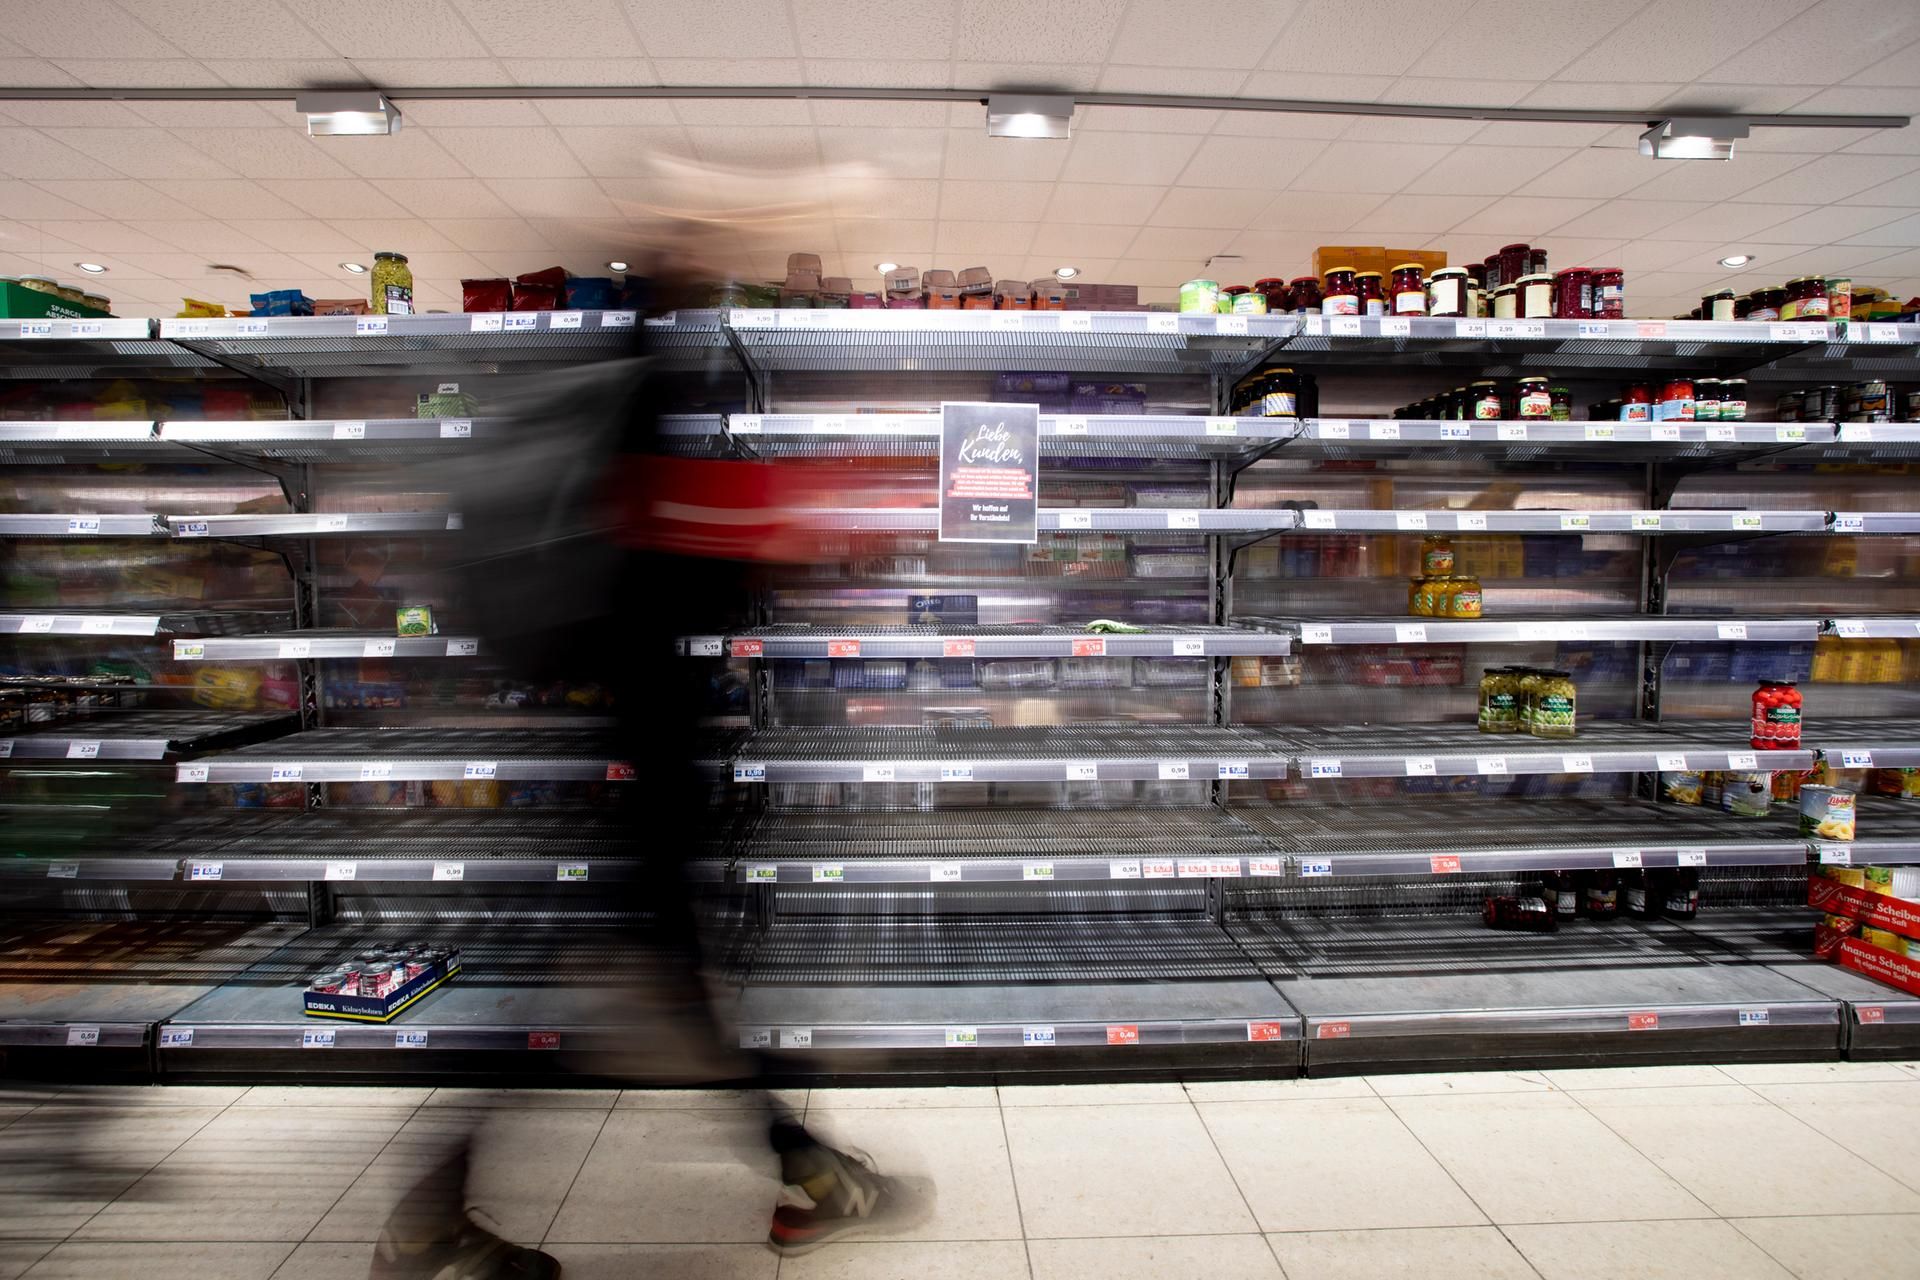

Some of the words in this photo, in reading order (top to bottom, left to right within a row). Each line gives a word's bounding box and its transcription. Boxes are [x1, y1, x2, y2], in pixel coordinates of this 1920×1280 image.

[976, 422, 1011, 442] Liebe
[958, 439, 1023, 464] Kunden,
[982, 504, 999, 512] hoffen
[1315, 631, 1329, 639] 1,99
[703, 643, 719, 651] 1,19
[743, 644, 760, 652] 0,59
[1186, 642, 1201, 650] 0,99
[943, 869, 958, 877] 0,89
[1836, 891, 1874, 910] Ananas
[1891, 917, 1908, 928] Saft
[1840, 941, 1877, 963] Ananas
[1862, 961, 1891, 977] eigenem
[1892, 971, 1908, 983] Saft
[387, 993, 410, 1012] EDEKA
[307, 1002, 335, 1011] EDEKA
[342, 1005, 383, 1016] Kidneybohnen
[1263, 1027, 1278, 1035] 1,19
[752, 1035, 768, 1043] 2,99
[793, 1035, 809, 1043] 1,19
